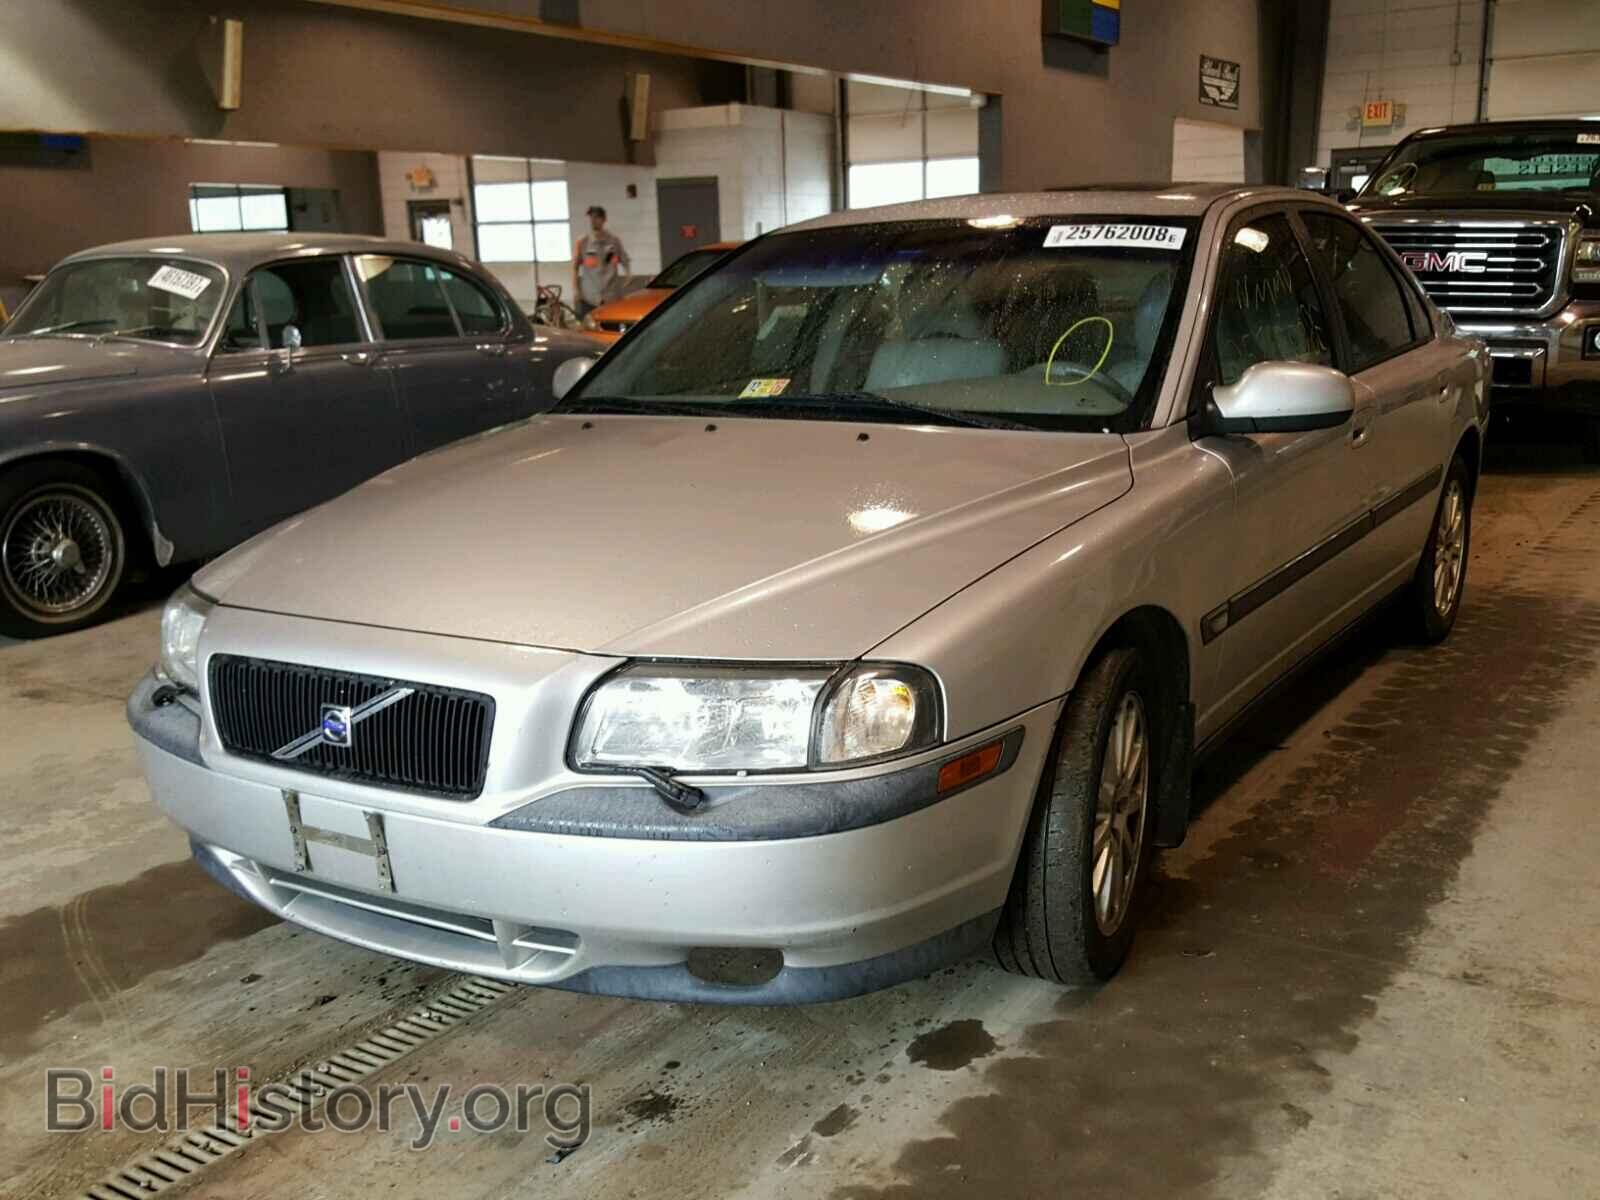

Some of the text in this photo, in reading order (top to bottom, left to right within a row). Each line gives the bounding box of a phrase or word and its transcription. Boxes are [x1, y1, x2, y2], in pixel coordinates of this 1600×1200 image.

[1367, 103, 1389, 119] EXIT
[1065, 225, 1169, 242] 25762008
[1402, 252, 1488, 273] GMC
